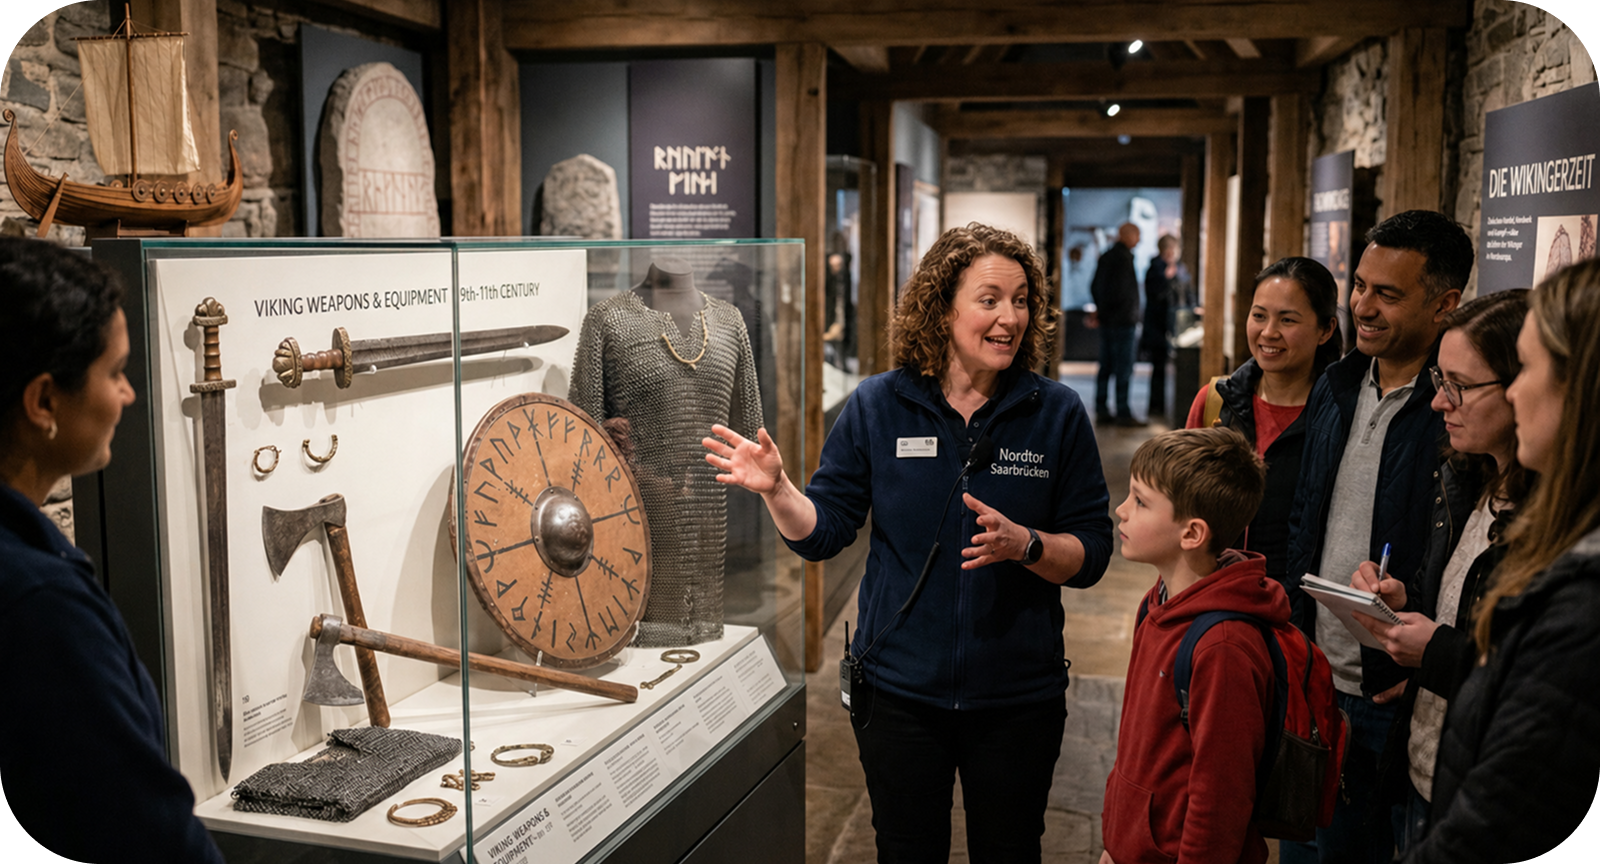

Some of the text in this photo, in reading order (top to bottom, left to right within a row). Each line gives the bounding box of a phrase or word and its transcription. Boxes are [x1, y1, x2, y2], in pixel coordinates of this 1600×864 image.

[1489, 154, 1596, 198] DIE WIKINGERZEIT
[254, 282, 540, 318] VIKING WEAPONS & EQUIPMENT 9th-11th CENTURY
[990, 463, 1050, 479] Saarbrücken
[999, 448, 1044, 464] Nordtor
[487, 835, 513, 859] VIKING
[512, 811, 546, 840] WEAPONS
